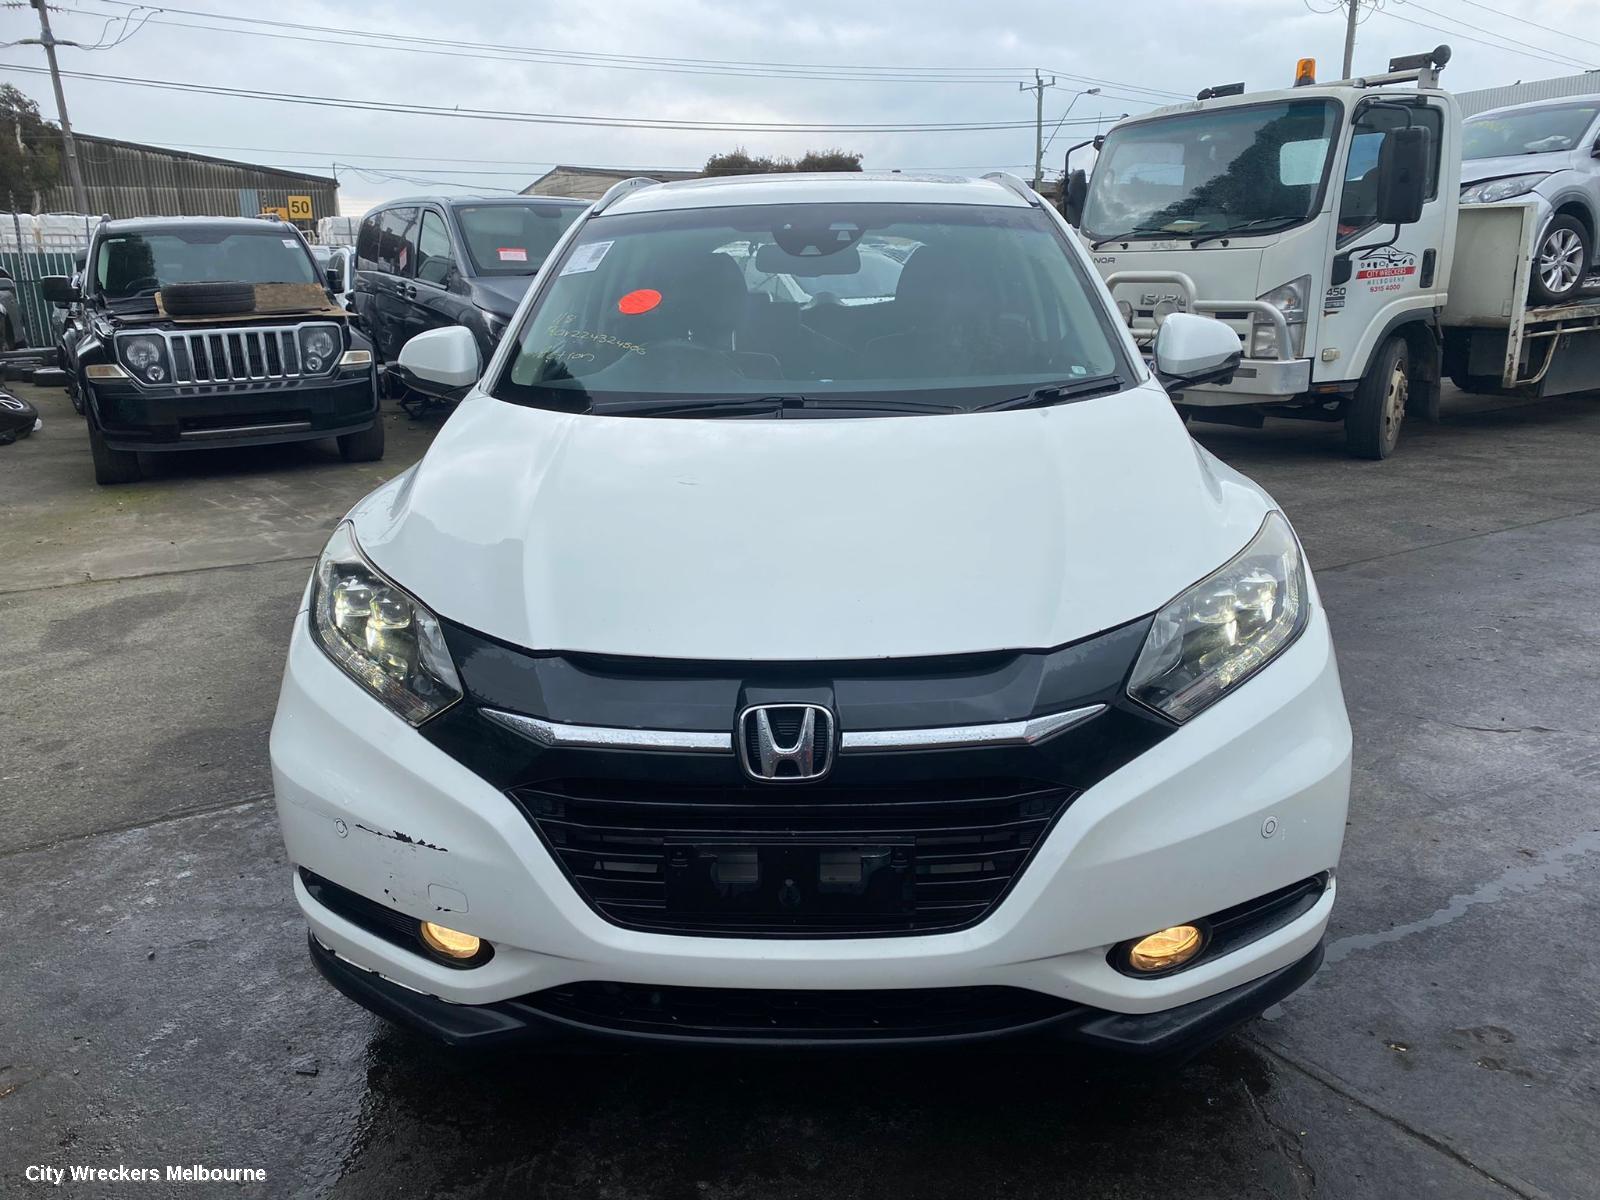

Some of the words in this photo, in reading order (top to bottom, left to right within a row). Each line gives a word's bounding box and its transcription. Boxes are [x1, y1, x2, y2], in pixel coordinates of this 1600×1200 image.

[291, 200, 310, 214] 50
[1379, 268, 1407, 276] WRECKERS
[1367, 277, 1405, 285] MELBOURNE
[1326, 287, 1347, 296] 450
